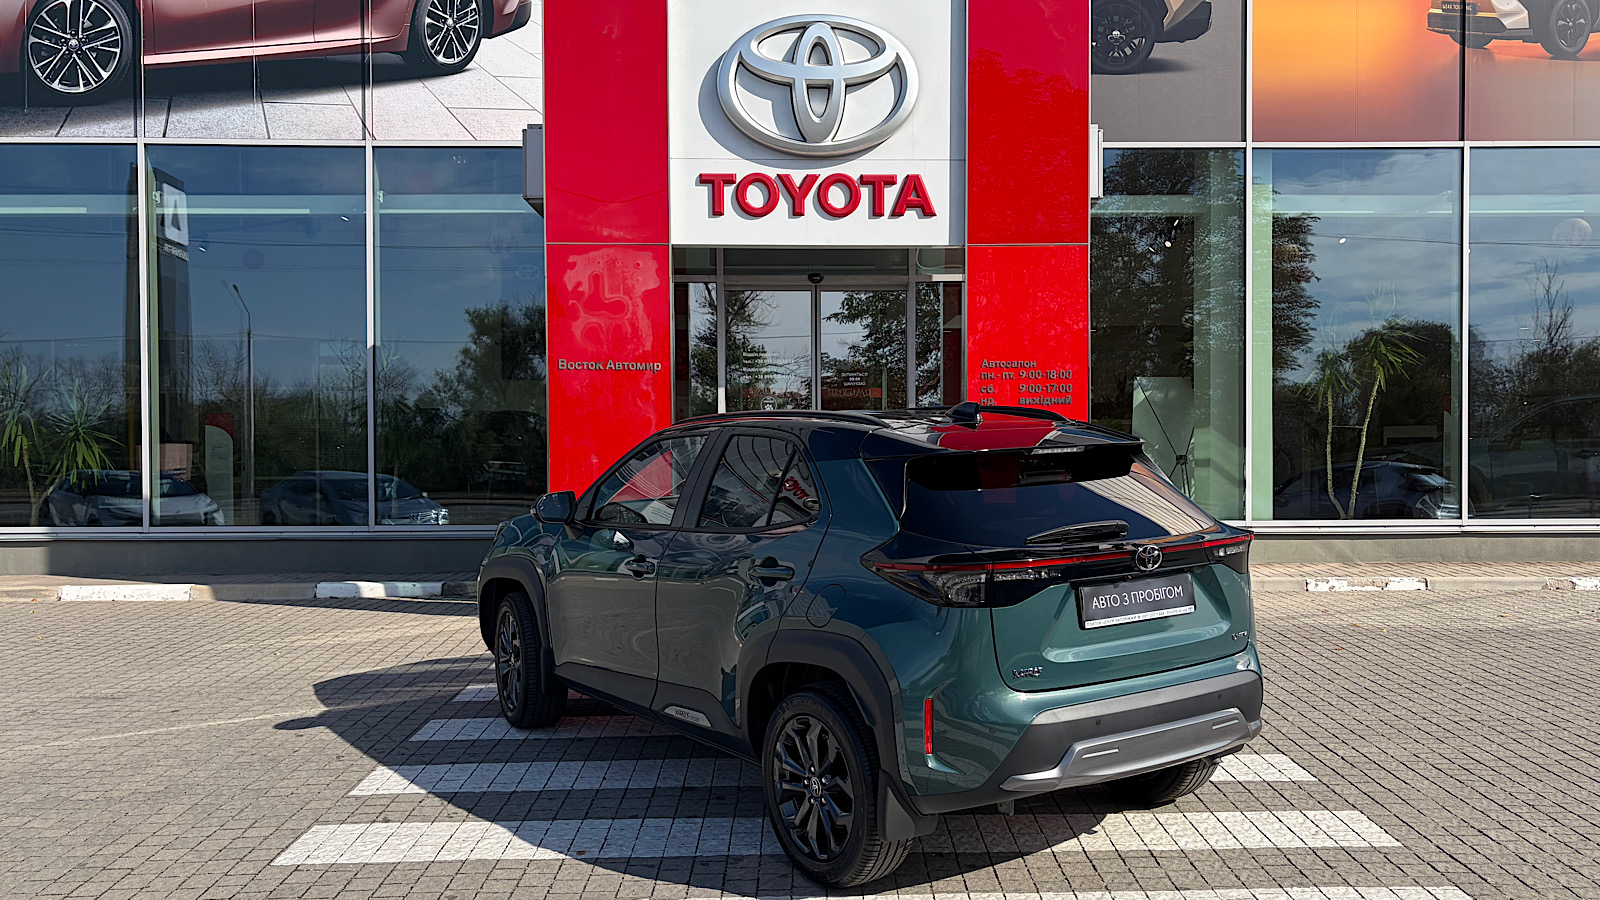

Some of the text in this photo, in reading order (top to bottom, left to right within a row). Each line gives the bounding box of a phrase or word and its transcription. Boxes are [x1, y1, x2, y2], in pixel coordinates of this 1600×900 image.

[699, 172, 938, 218] TOYOTA
[558, 359, 662, 374] Восток Автомир
[981, 359, 1037, 369] Автосалон
[1019, 370, 1073, 379] 9:00-18:00
[981, 383, 1073, 394] сб. 9:00-17:00
[981, 395, 1073, 406] нд. вихідний
[1092, 594, 1120, 610] АВТО
[1131, 585, 1184, 604] ПРОБІГОМ
